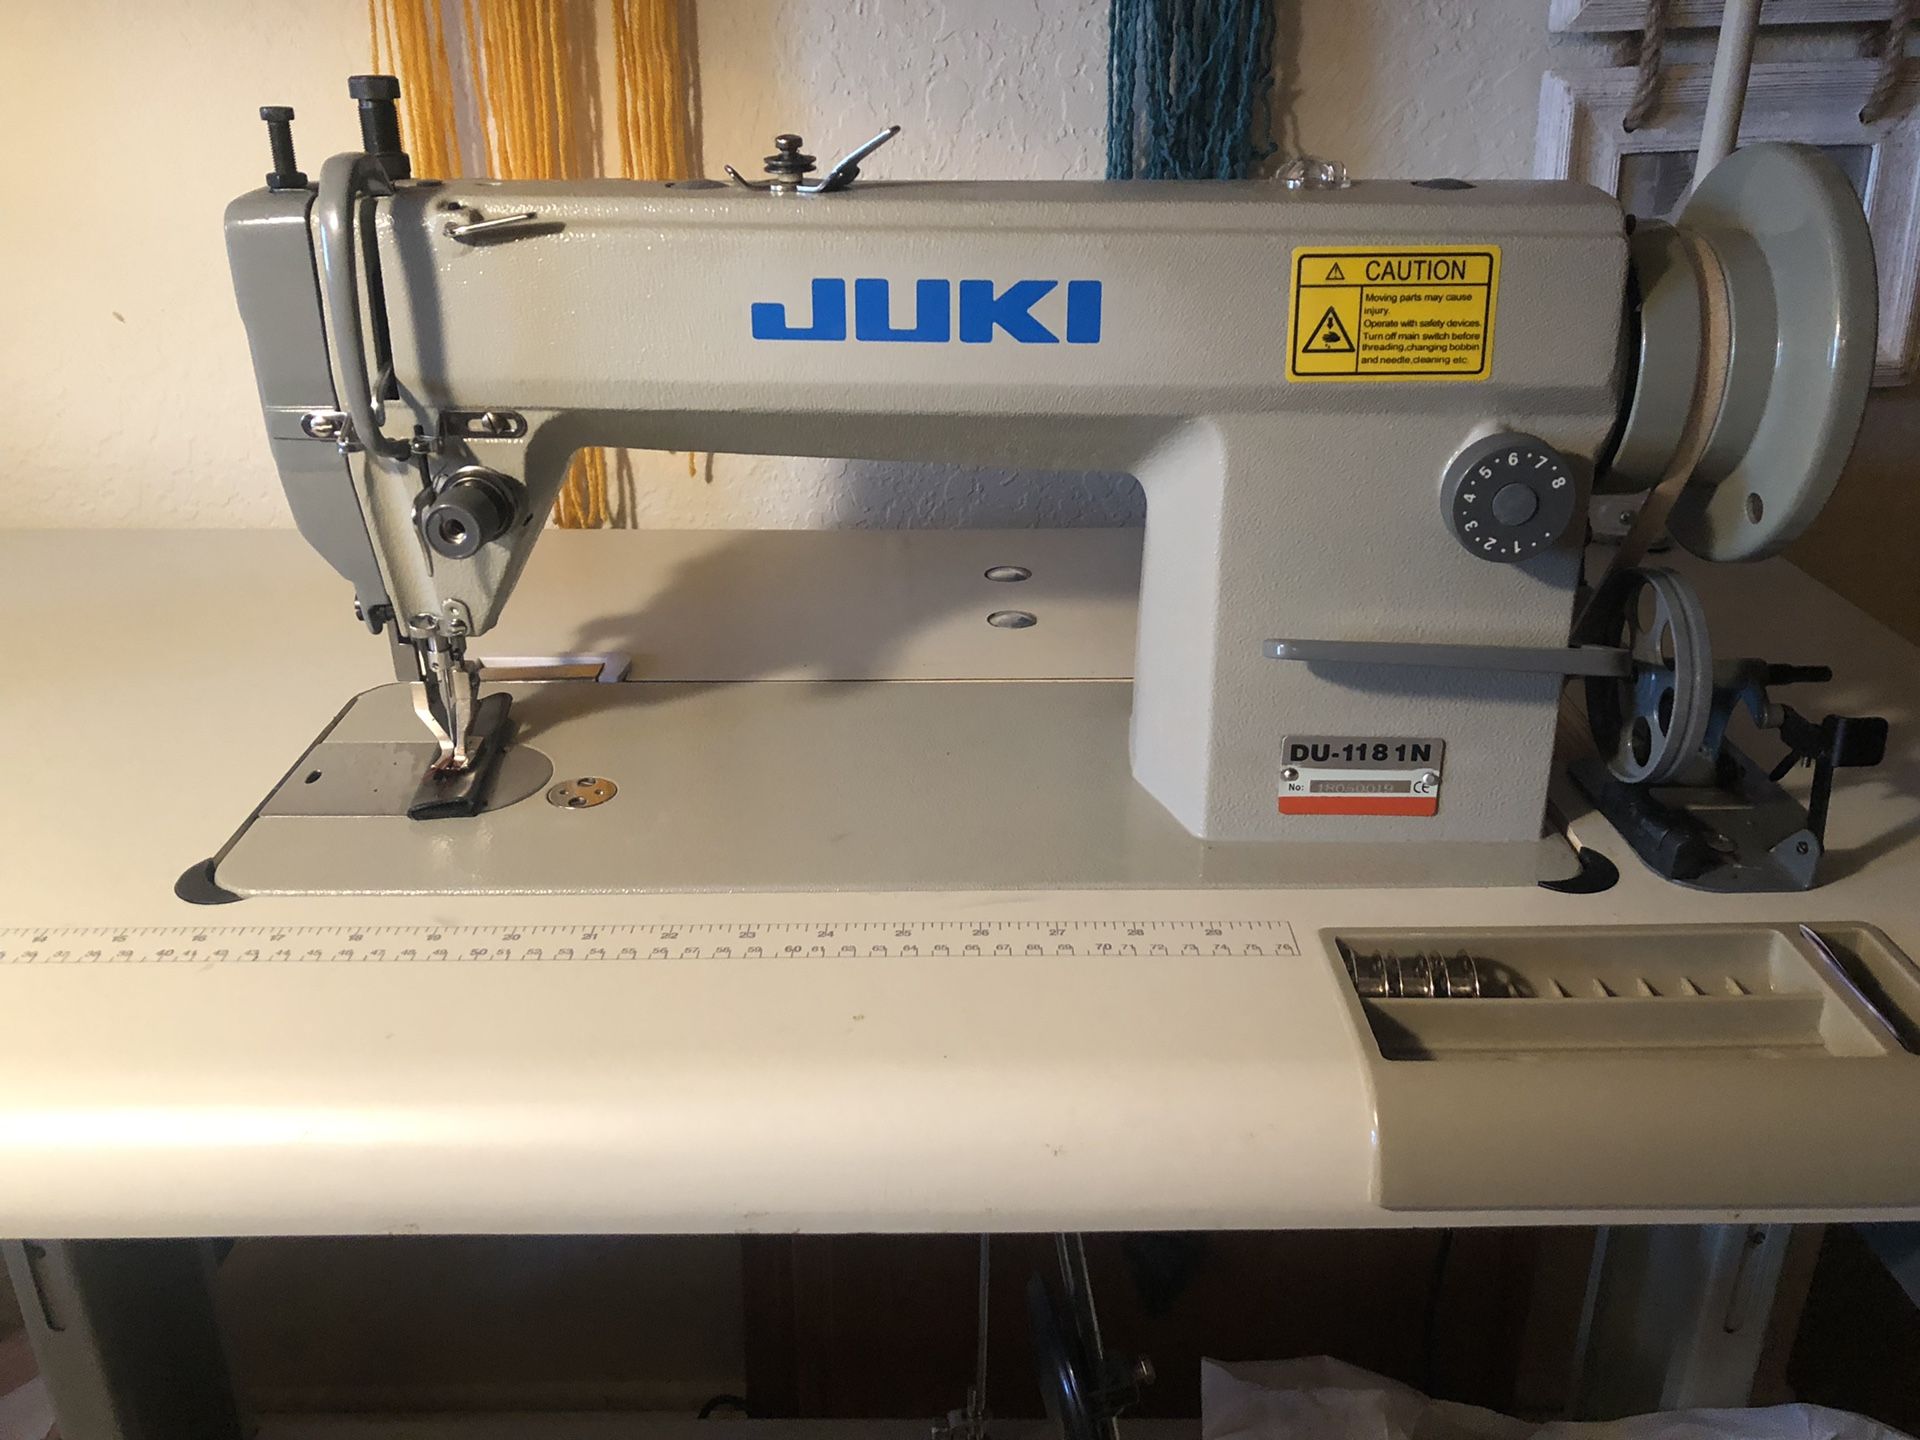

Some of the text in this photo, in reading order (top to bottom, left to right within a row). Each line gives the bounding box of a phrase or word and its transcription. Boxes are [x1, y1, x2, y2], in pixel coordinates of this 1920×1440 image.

[1365, 259, 1466, 281] CAUTION
[1365, 293, 1397, 304] Moving
[1400, 294, 1422, 304] parts
[1424, 294, 1443, 303] may
[751, 278, 1102, 343] JUKI
[1364, 307, 1390, 316] injury.
[1363, 319, 1481, 329] Operate with safety devices.
[1363, 331, 1481, 341] Turn off main switch before
[1449, 342, 1480, 351] bobbin
[1361, 355, 1379, 364] and
[1507, 452, 1519, 466] 6
[1534, 455, 1549, 469] 7
[1478, 465, 1492, 479] 5
[1551, 476, 1566, 489] 8
[1463, 492, 1477, 503] 4
[1464, 520, 1479, 532] 3
[1483, 536, 1497, 550] 2
[1513, 540, 1522, 554] 1
[1290, 743, 1432, 762] DU-1181N
[1288, 783, 1305, 792] No:
[502, 933, 521, 941] 20
[817, 930, 834, 938] 24
